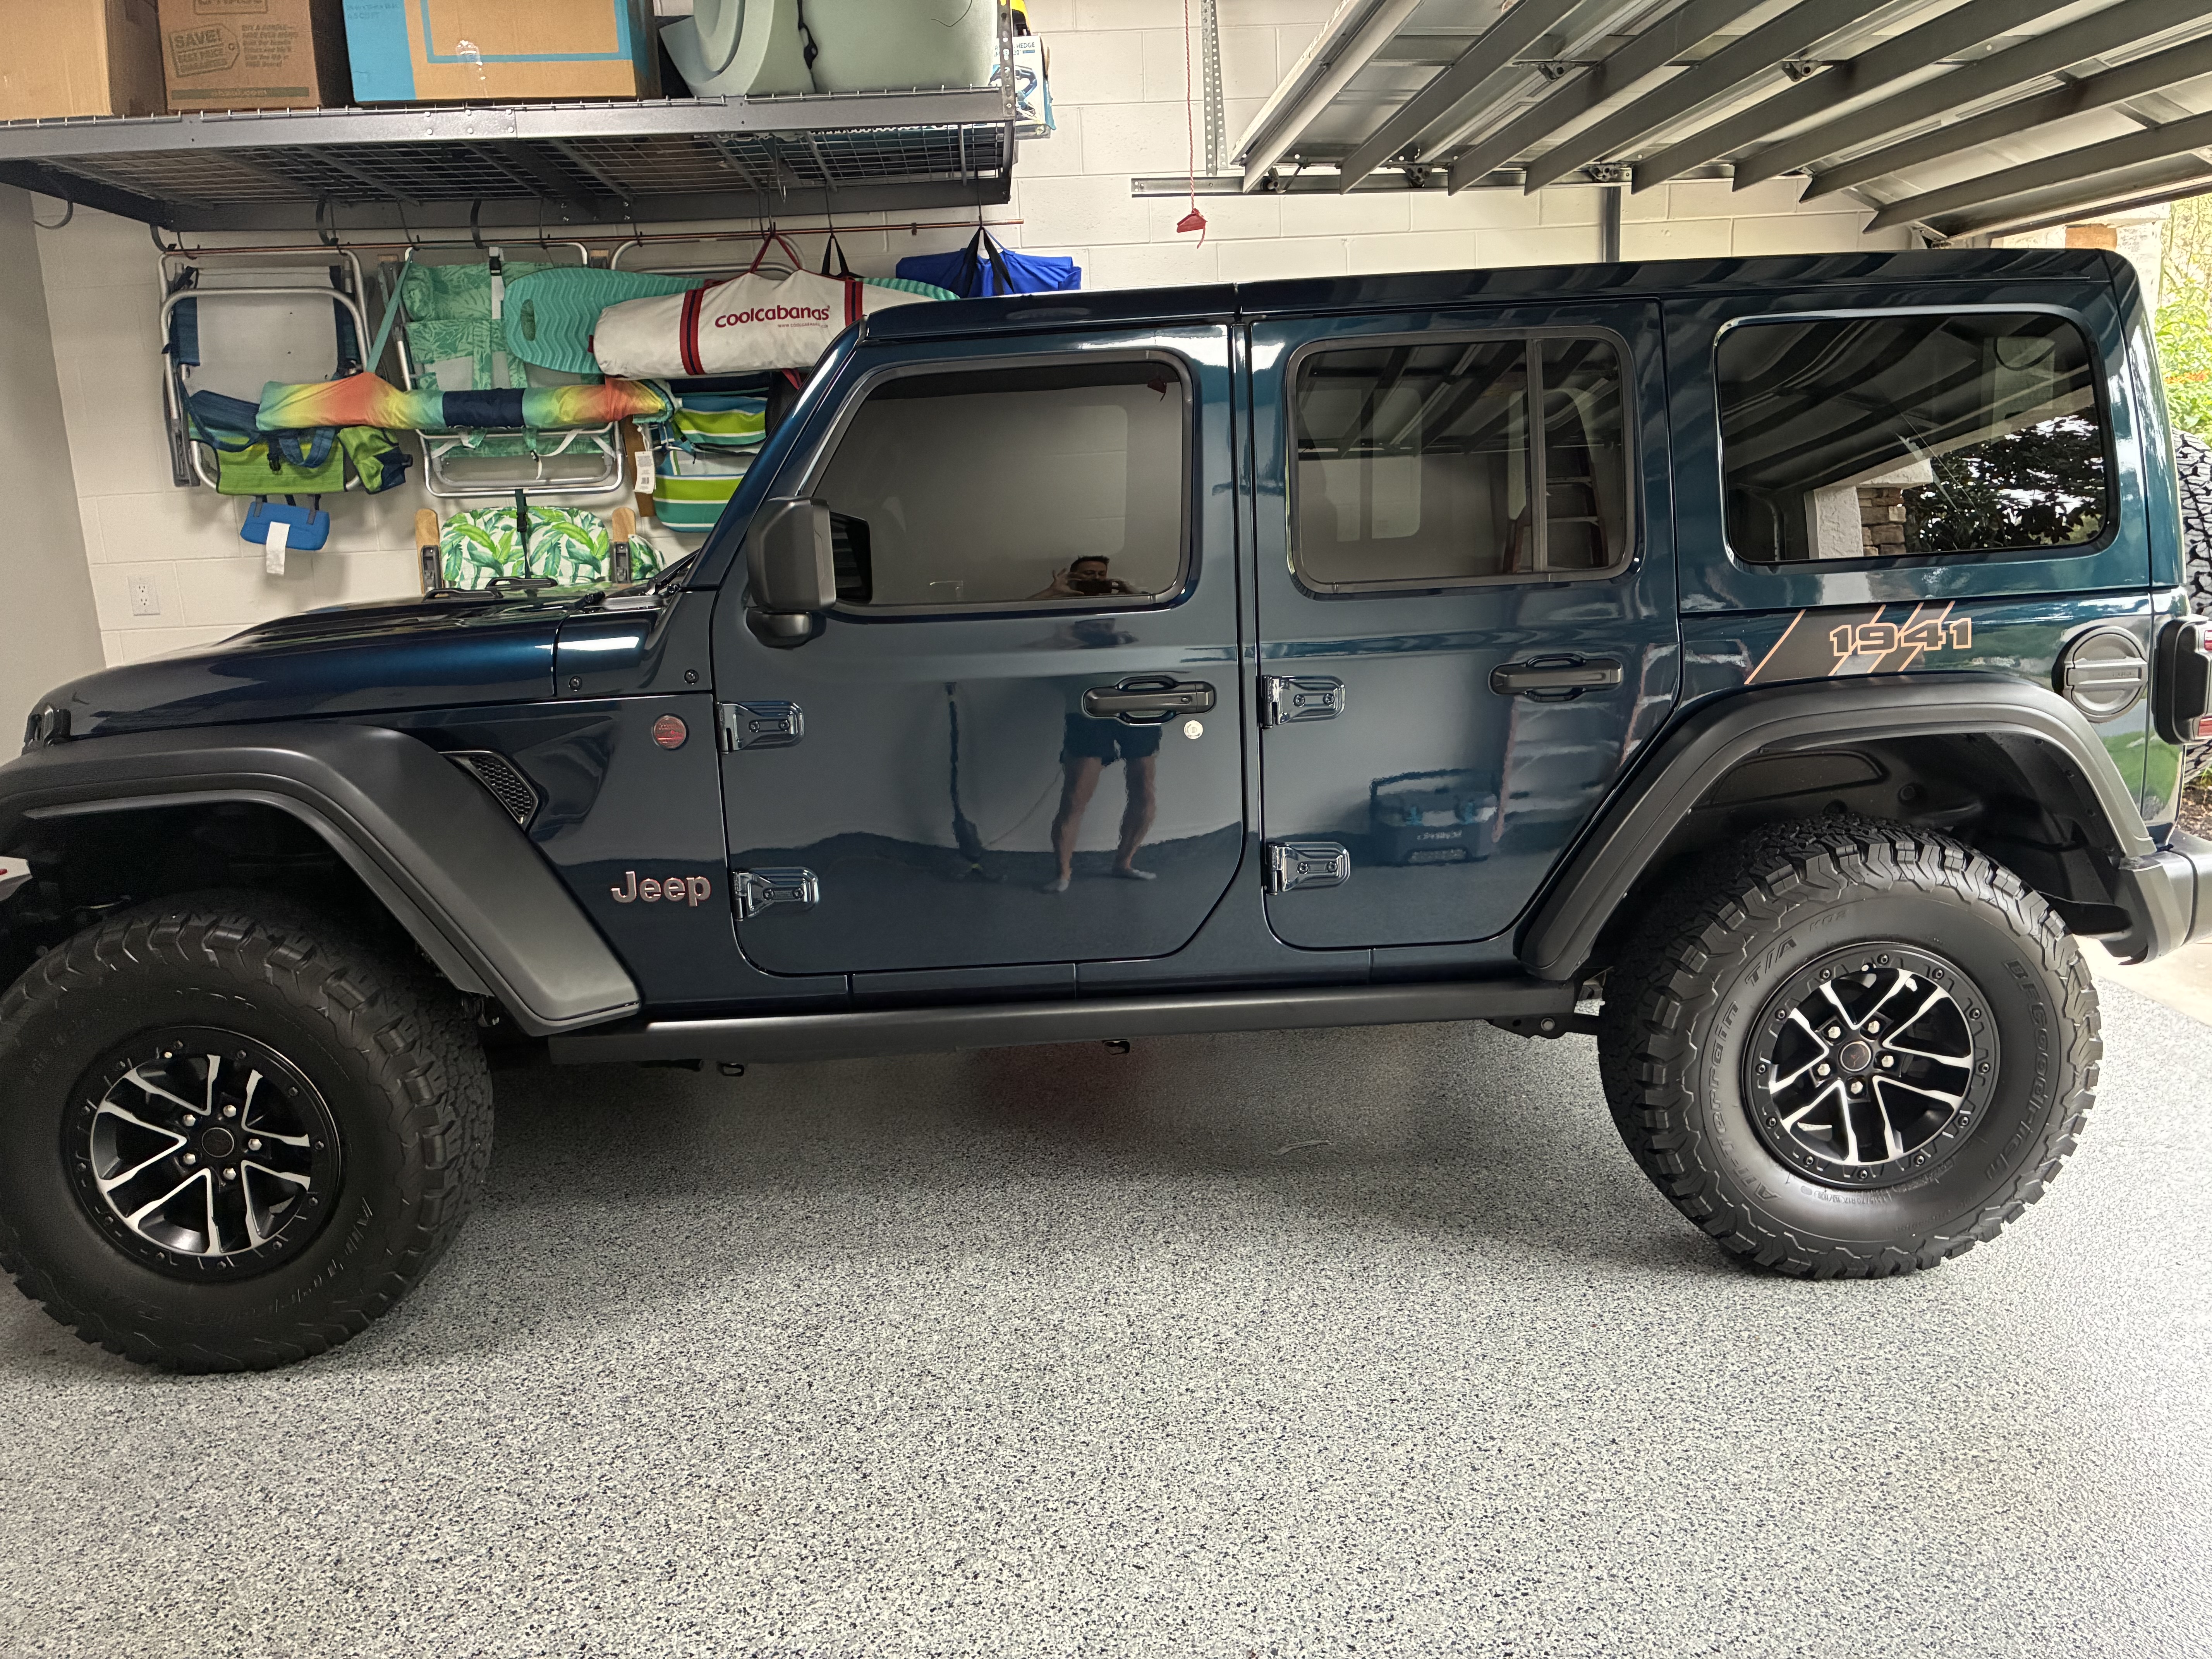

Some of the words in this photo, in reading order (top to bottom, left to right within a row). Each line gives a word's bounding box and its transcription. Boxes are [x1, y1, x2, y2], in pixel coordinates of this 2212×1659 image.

[174, 29, 222, 48] SAVE!
[715, 305, 830, 328] coolcabanas
[1829, 617, 1972, 657] 1941
[610, 871, 711, 907] Jeep
[1745, 935, 1797, 987] T/A
[1984, 958, 2050, 1181] BFGoodrich
[1709, 1000, 1783, 1203] All-Terrain
